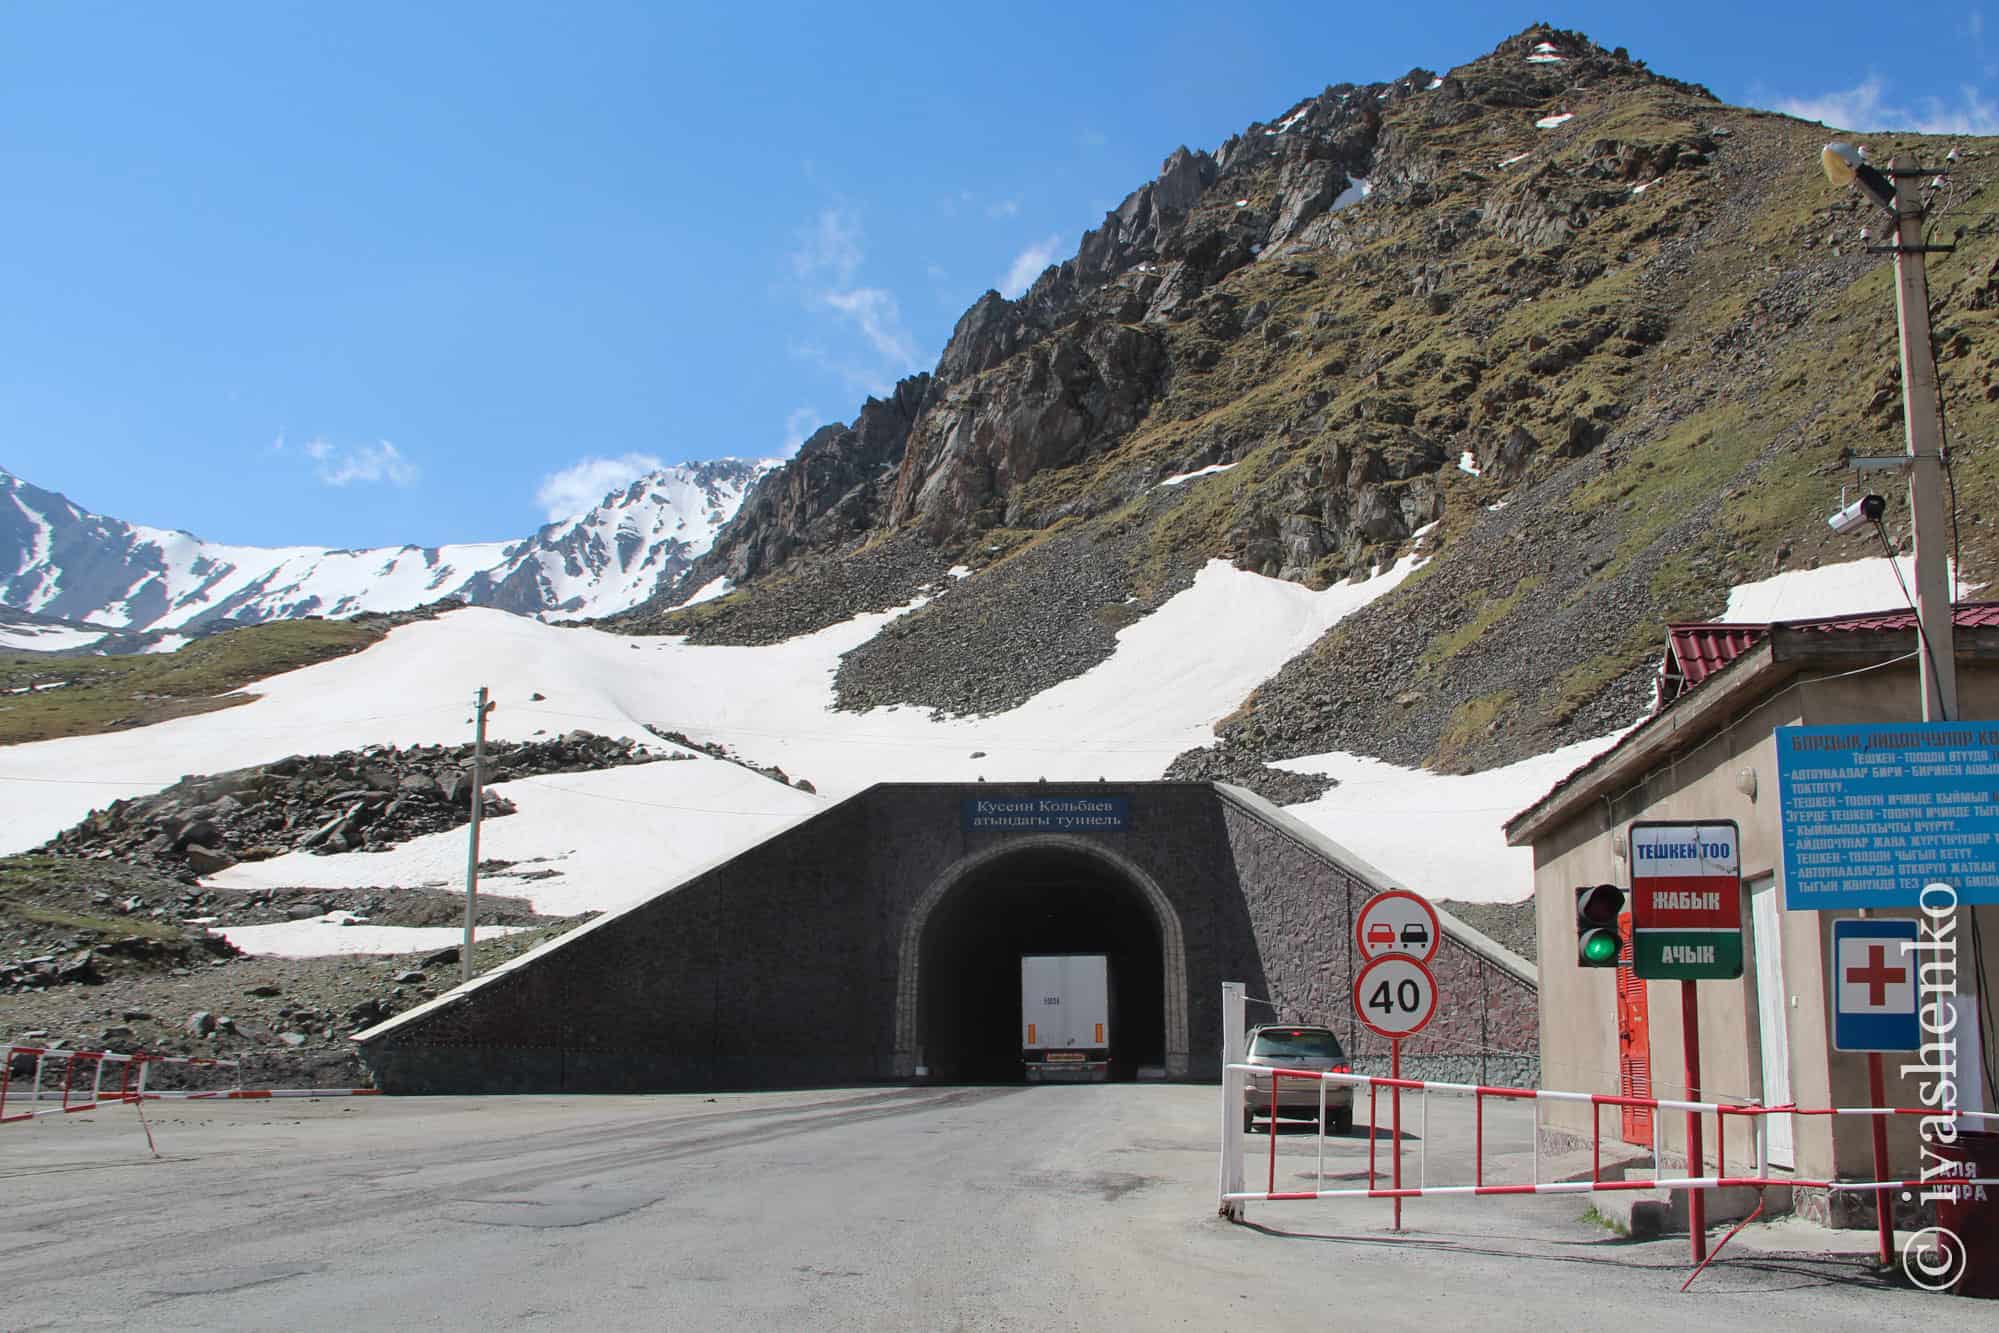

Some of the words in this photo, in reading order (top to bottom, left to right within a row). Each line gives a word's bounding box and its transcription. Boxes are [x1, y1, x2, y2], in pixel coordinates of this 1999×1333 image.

[1637, 843, 1696, 860] ТЕШКЕН
[1700, 843, 1730, 859] ТОО
[1652, 891, 1721, 911] ЖАБЫК
[1661, 945, 1715, 964] АЧЫК
[1369, 978, 1420, 1014] 40
